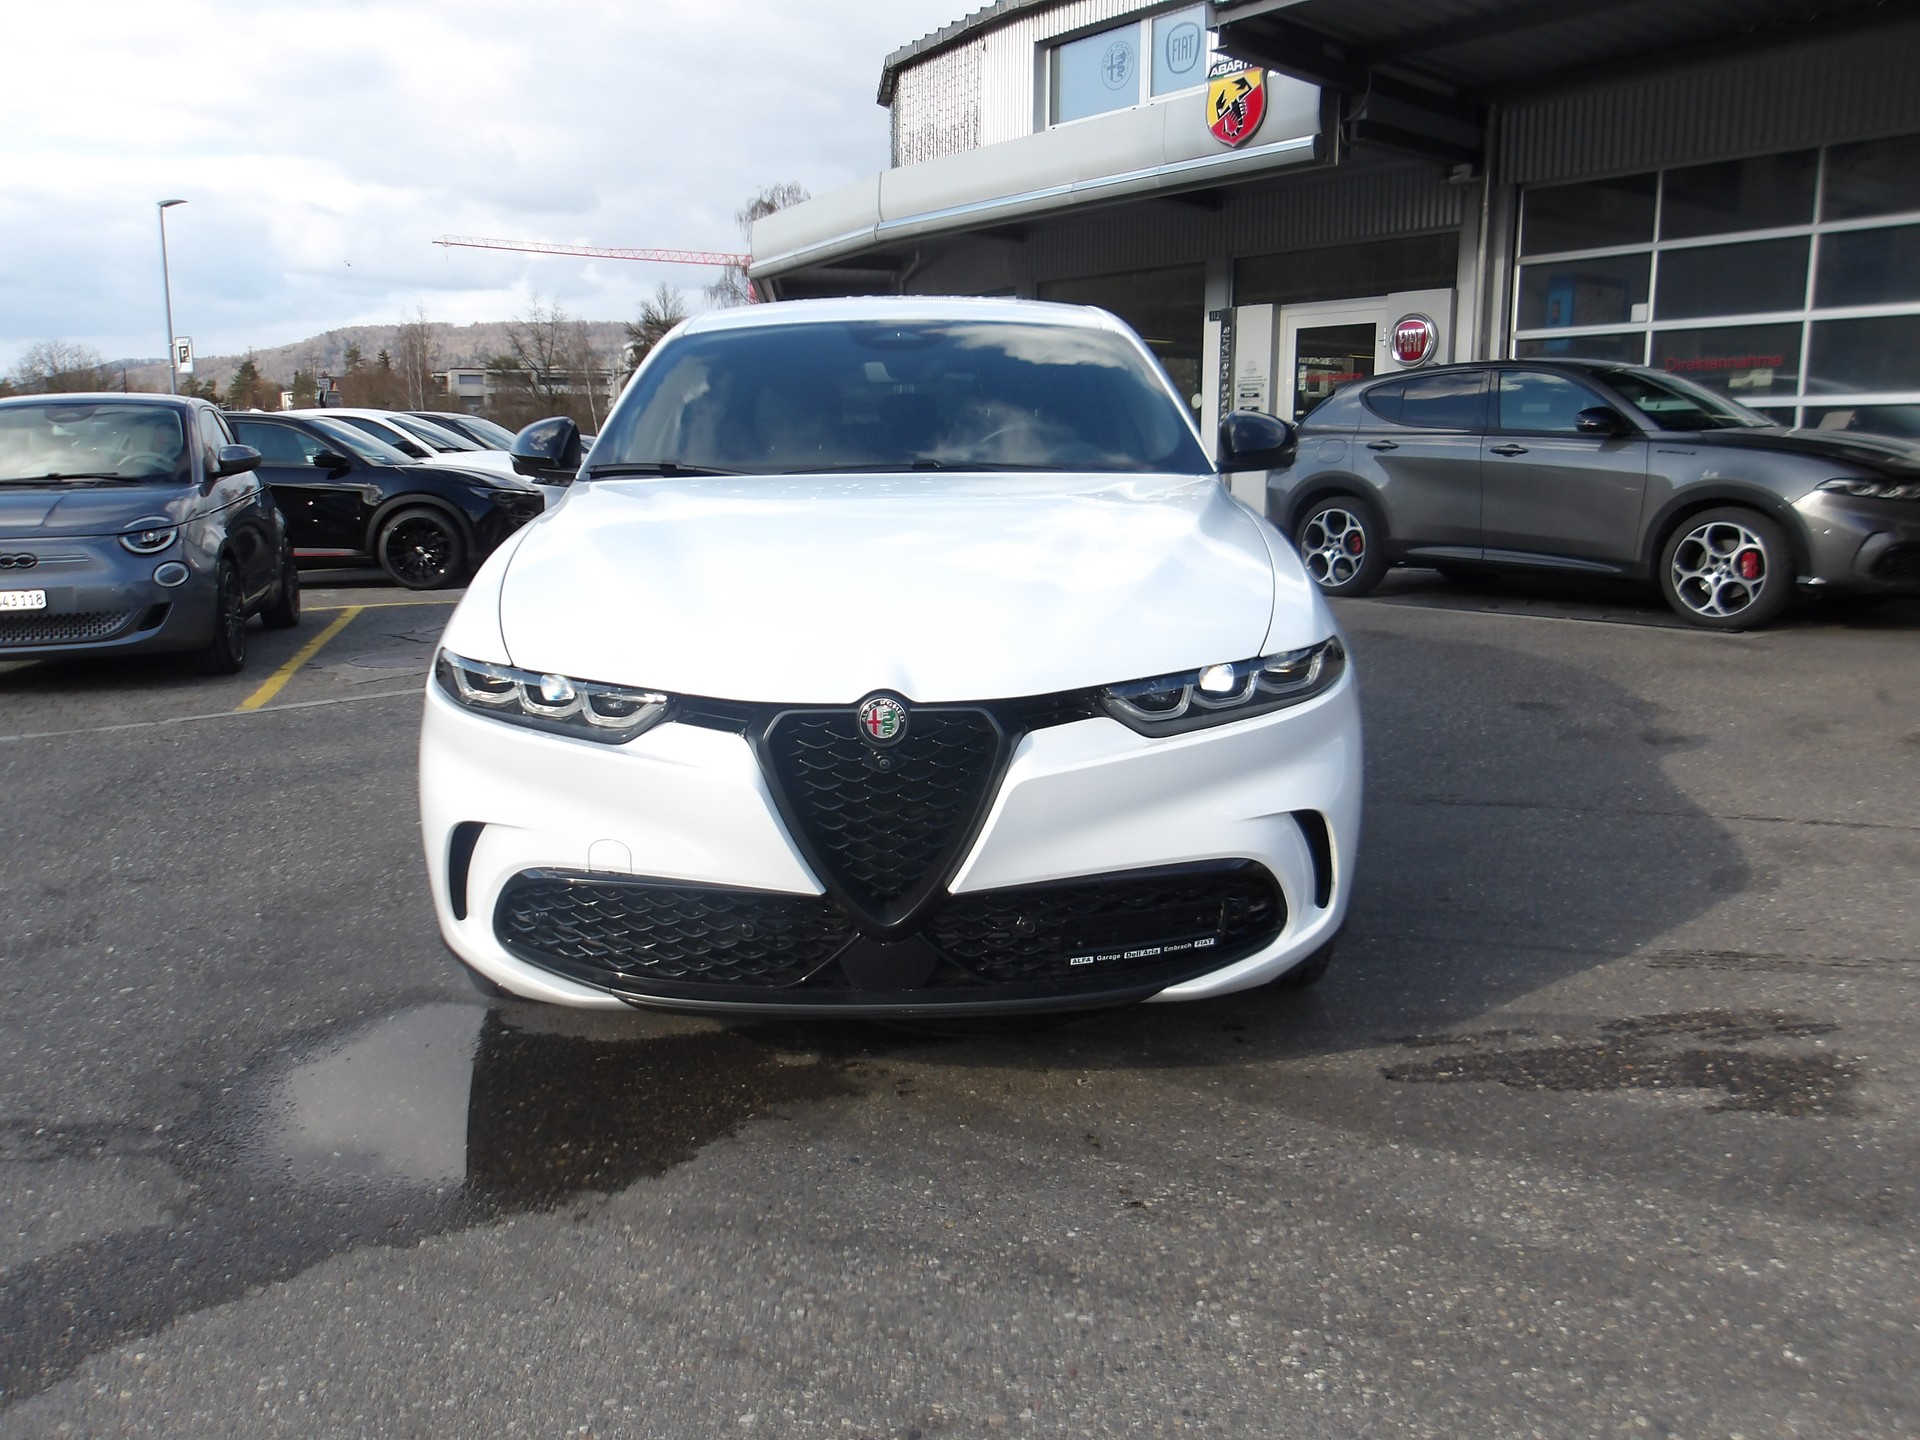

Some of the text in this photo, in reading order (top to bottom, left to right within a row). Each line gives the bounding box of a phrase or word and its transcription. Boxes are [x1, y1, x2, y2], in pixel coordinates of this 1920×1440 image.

[1172, 34, 1194, 63] FIAT
[1210, 60, 1252, 77] ABAR
[1210, 312, 1220, 320] 112
[1398, 328, 1425, 352] FIAT
[1664, 355, 1783, 372] Direktannahme
[880, 701, 905, 723] ROMEO
[1071, 957, 1093, 965] ALFA
[1163, 942, 1192, 952] Embrach
[1194, 938, 1215, 947] FIAT
